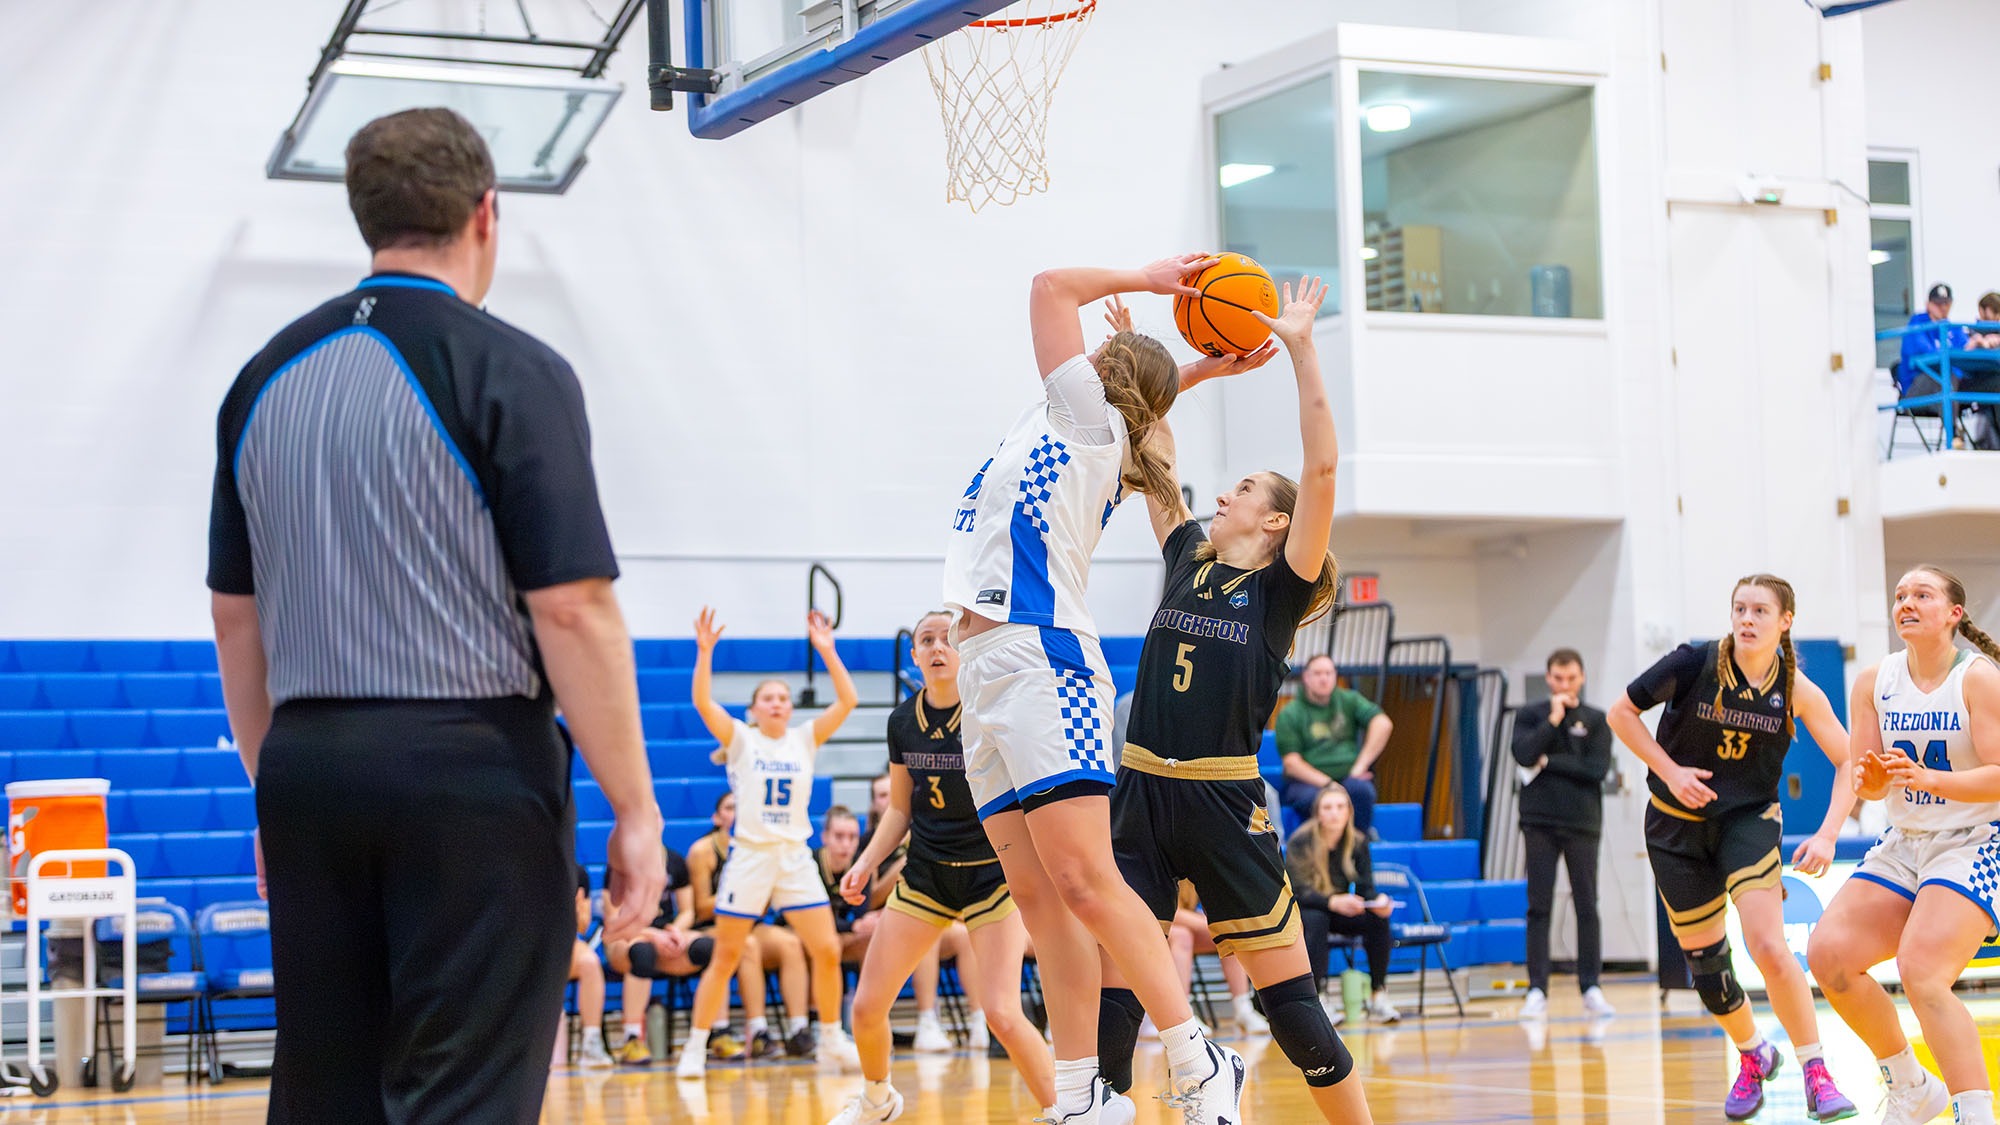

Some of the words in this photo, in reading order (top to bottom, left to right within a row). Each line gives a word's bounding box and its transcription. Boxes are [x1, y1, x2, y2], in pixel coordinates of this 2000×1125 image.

[1172, 642, 1197, 692] 5
[1697, 702, 1782, 733] HUGHTON
[1884, 711, 1961, 731] FREDONIA
[1717, 729, 1752, 760] 33
[902, 752, 965, 770] OUGHTO
[764, 778, 792, 806] 15
[927, 776, 945, 810] 3
